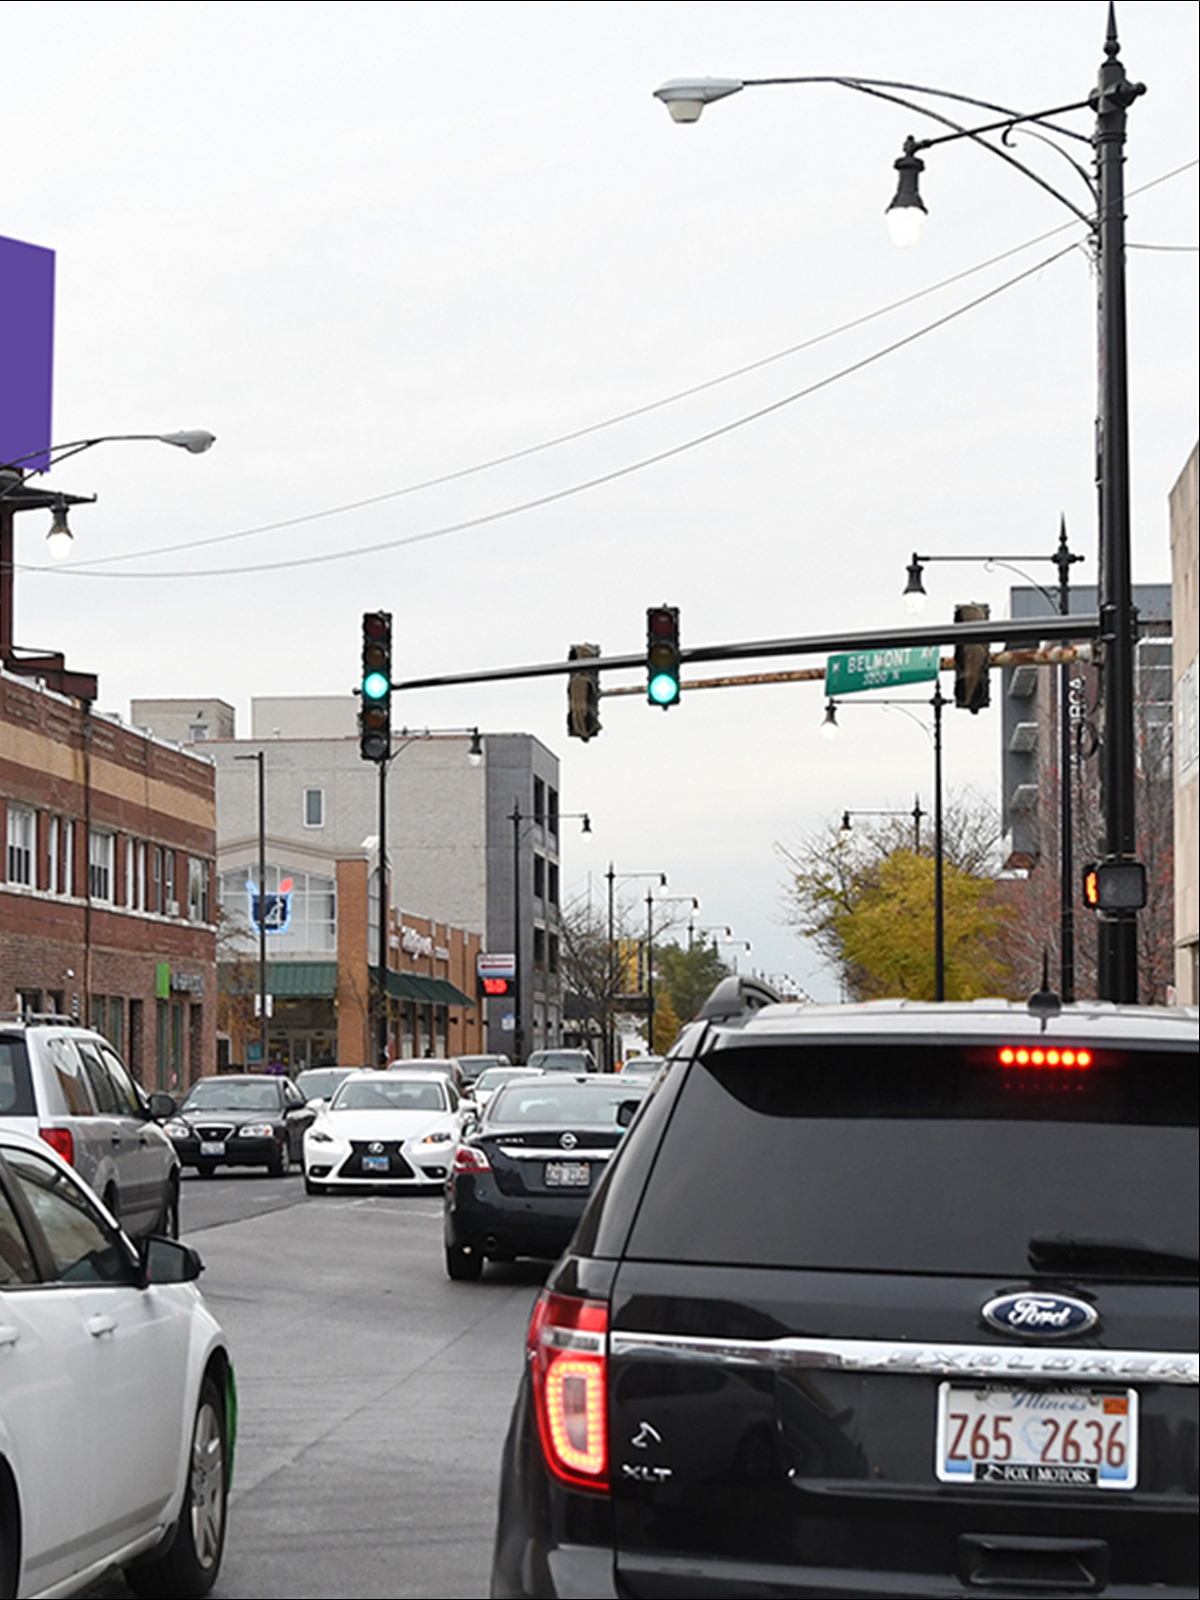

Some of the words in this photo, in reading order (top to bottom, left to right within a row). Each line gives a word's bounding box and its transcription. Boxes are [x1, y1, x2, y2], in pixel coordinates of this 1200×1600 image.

[846, 651, 911, 674] BELMONT
[1007, 1299, 1072, 1327] Ford
[887, 1349, 1194, 1376] EXPLORER
[1010, 1389, 1088, 1412] Illinois
[948, 1413, 1013, 1462] Z65
[1040, 1417, 1127, 1469] 2636
[622, 1463, 673, 1482] XLT
[1003, 1464, 1030, 1481] FOX
[1037, 1467, 1092, 1483] MOTORS
